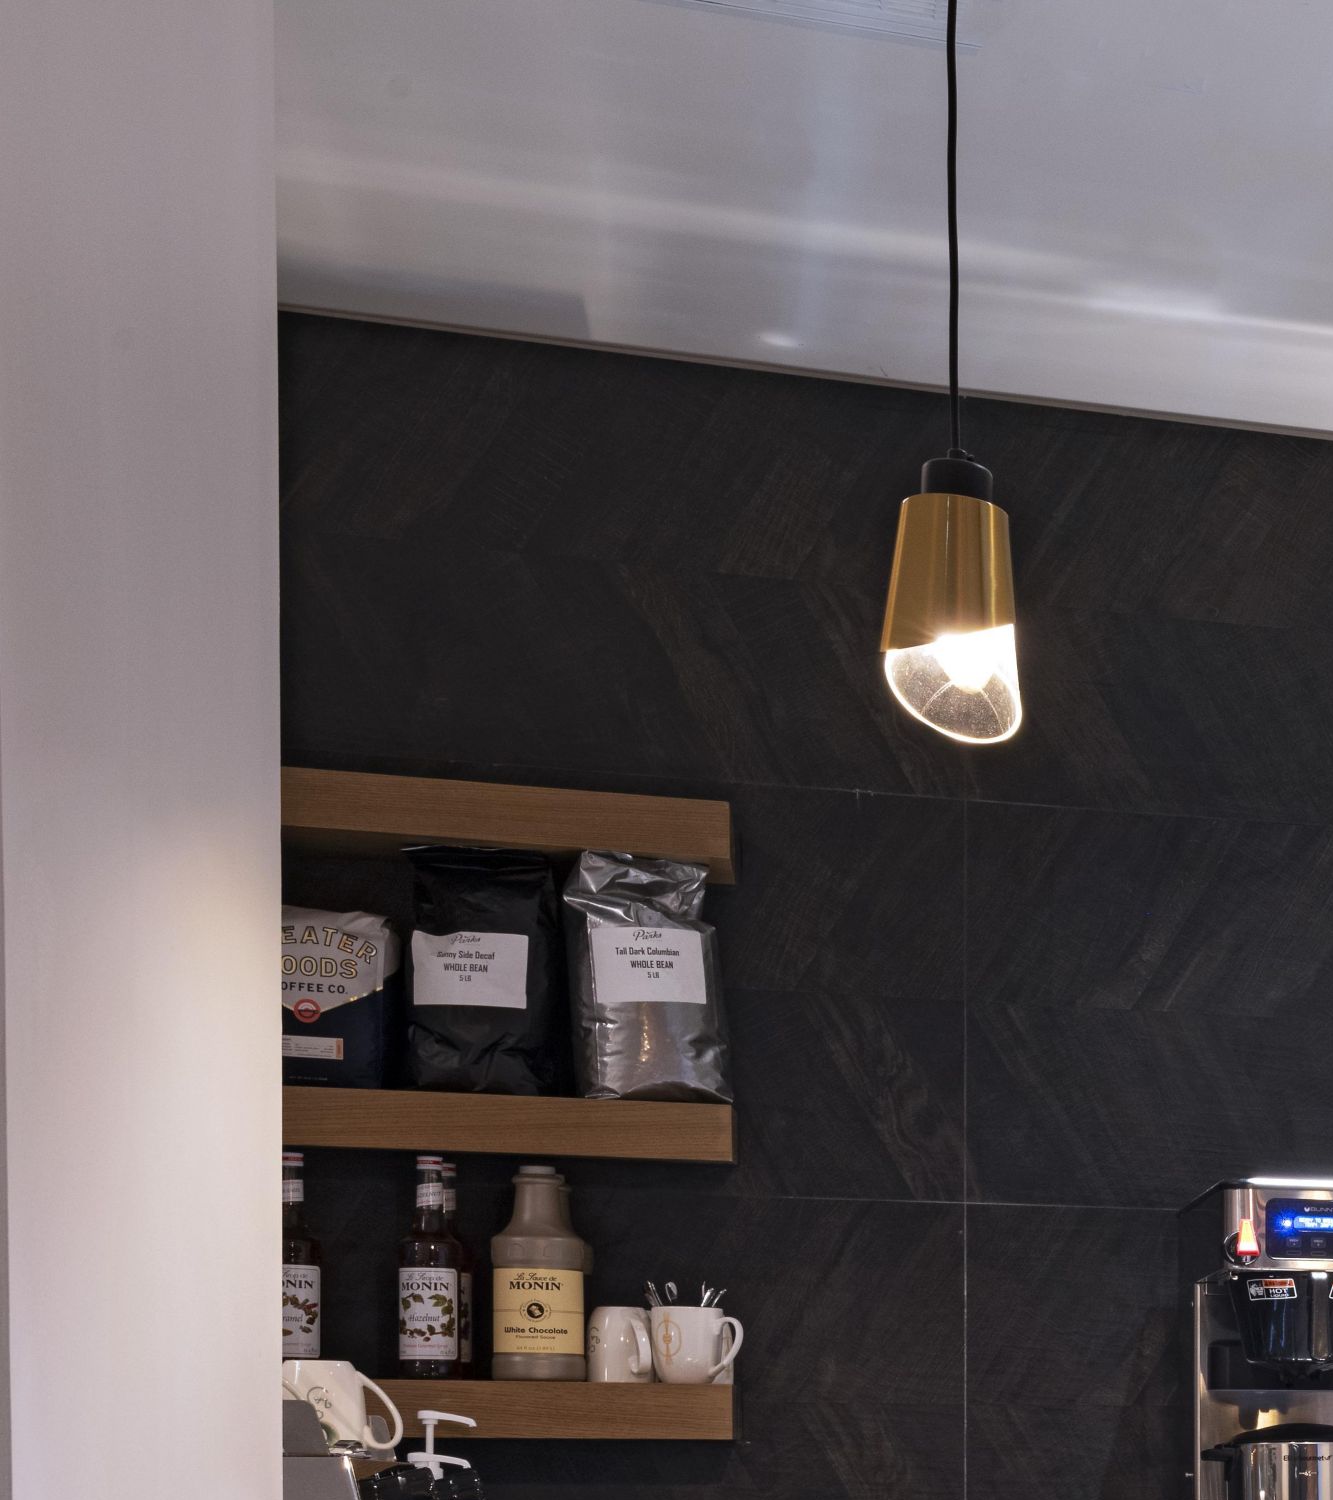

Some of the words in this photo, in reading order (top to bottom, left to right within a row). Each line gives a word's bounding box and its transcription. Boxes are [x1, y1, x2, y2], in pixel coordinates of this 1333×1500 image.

[458, 951, 473, 959] Side
[475, 951, 495, 960] Decaf
[615, 947, 627, 956] Tall
[629, 947, 645, 956] Dark
[647, 947, 680, 957] Columbian
[444, 963, 467, 972] WHOLE
[469, 963, 489, 973] BEAN
[630, 960, 654, 969] WHOLE
[656, 961, 674, 969] BEAN
[401, 1281, 450, 1291] MONIN
[509, 1281, 561, 1291] MONIN
[408, 1312, 441, 1322] Hazelnut
[528, 1327, 568, 1335] Chocolate
